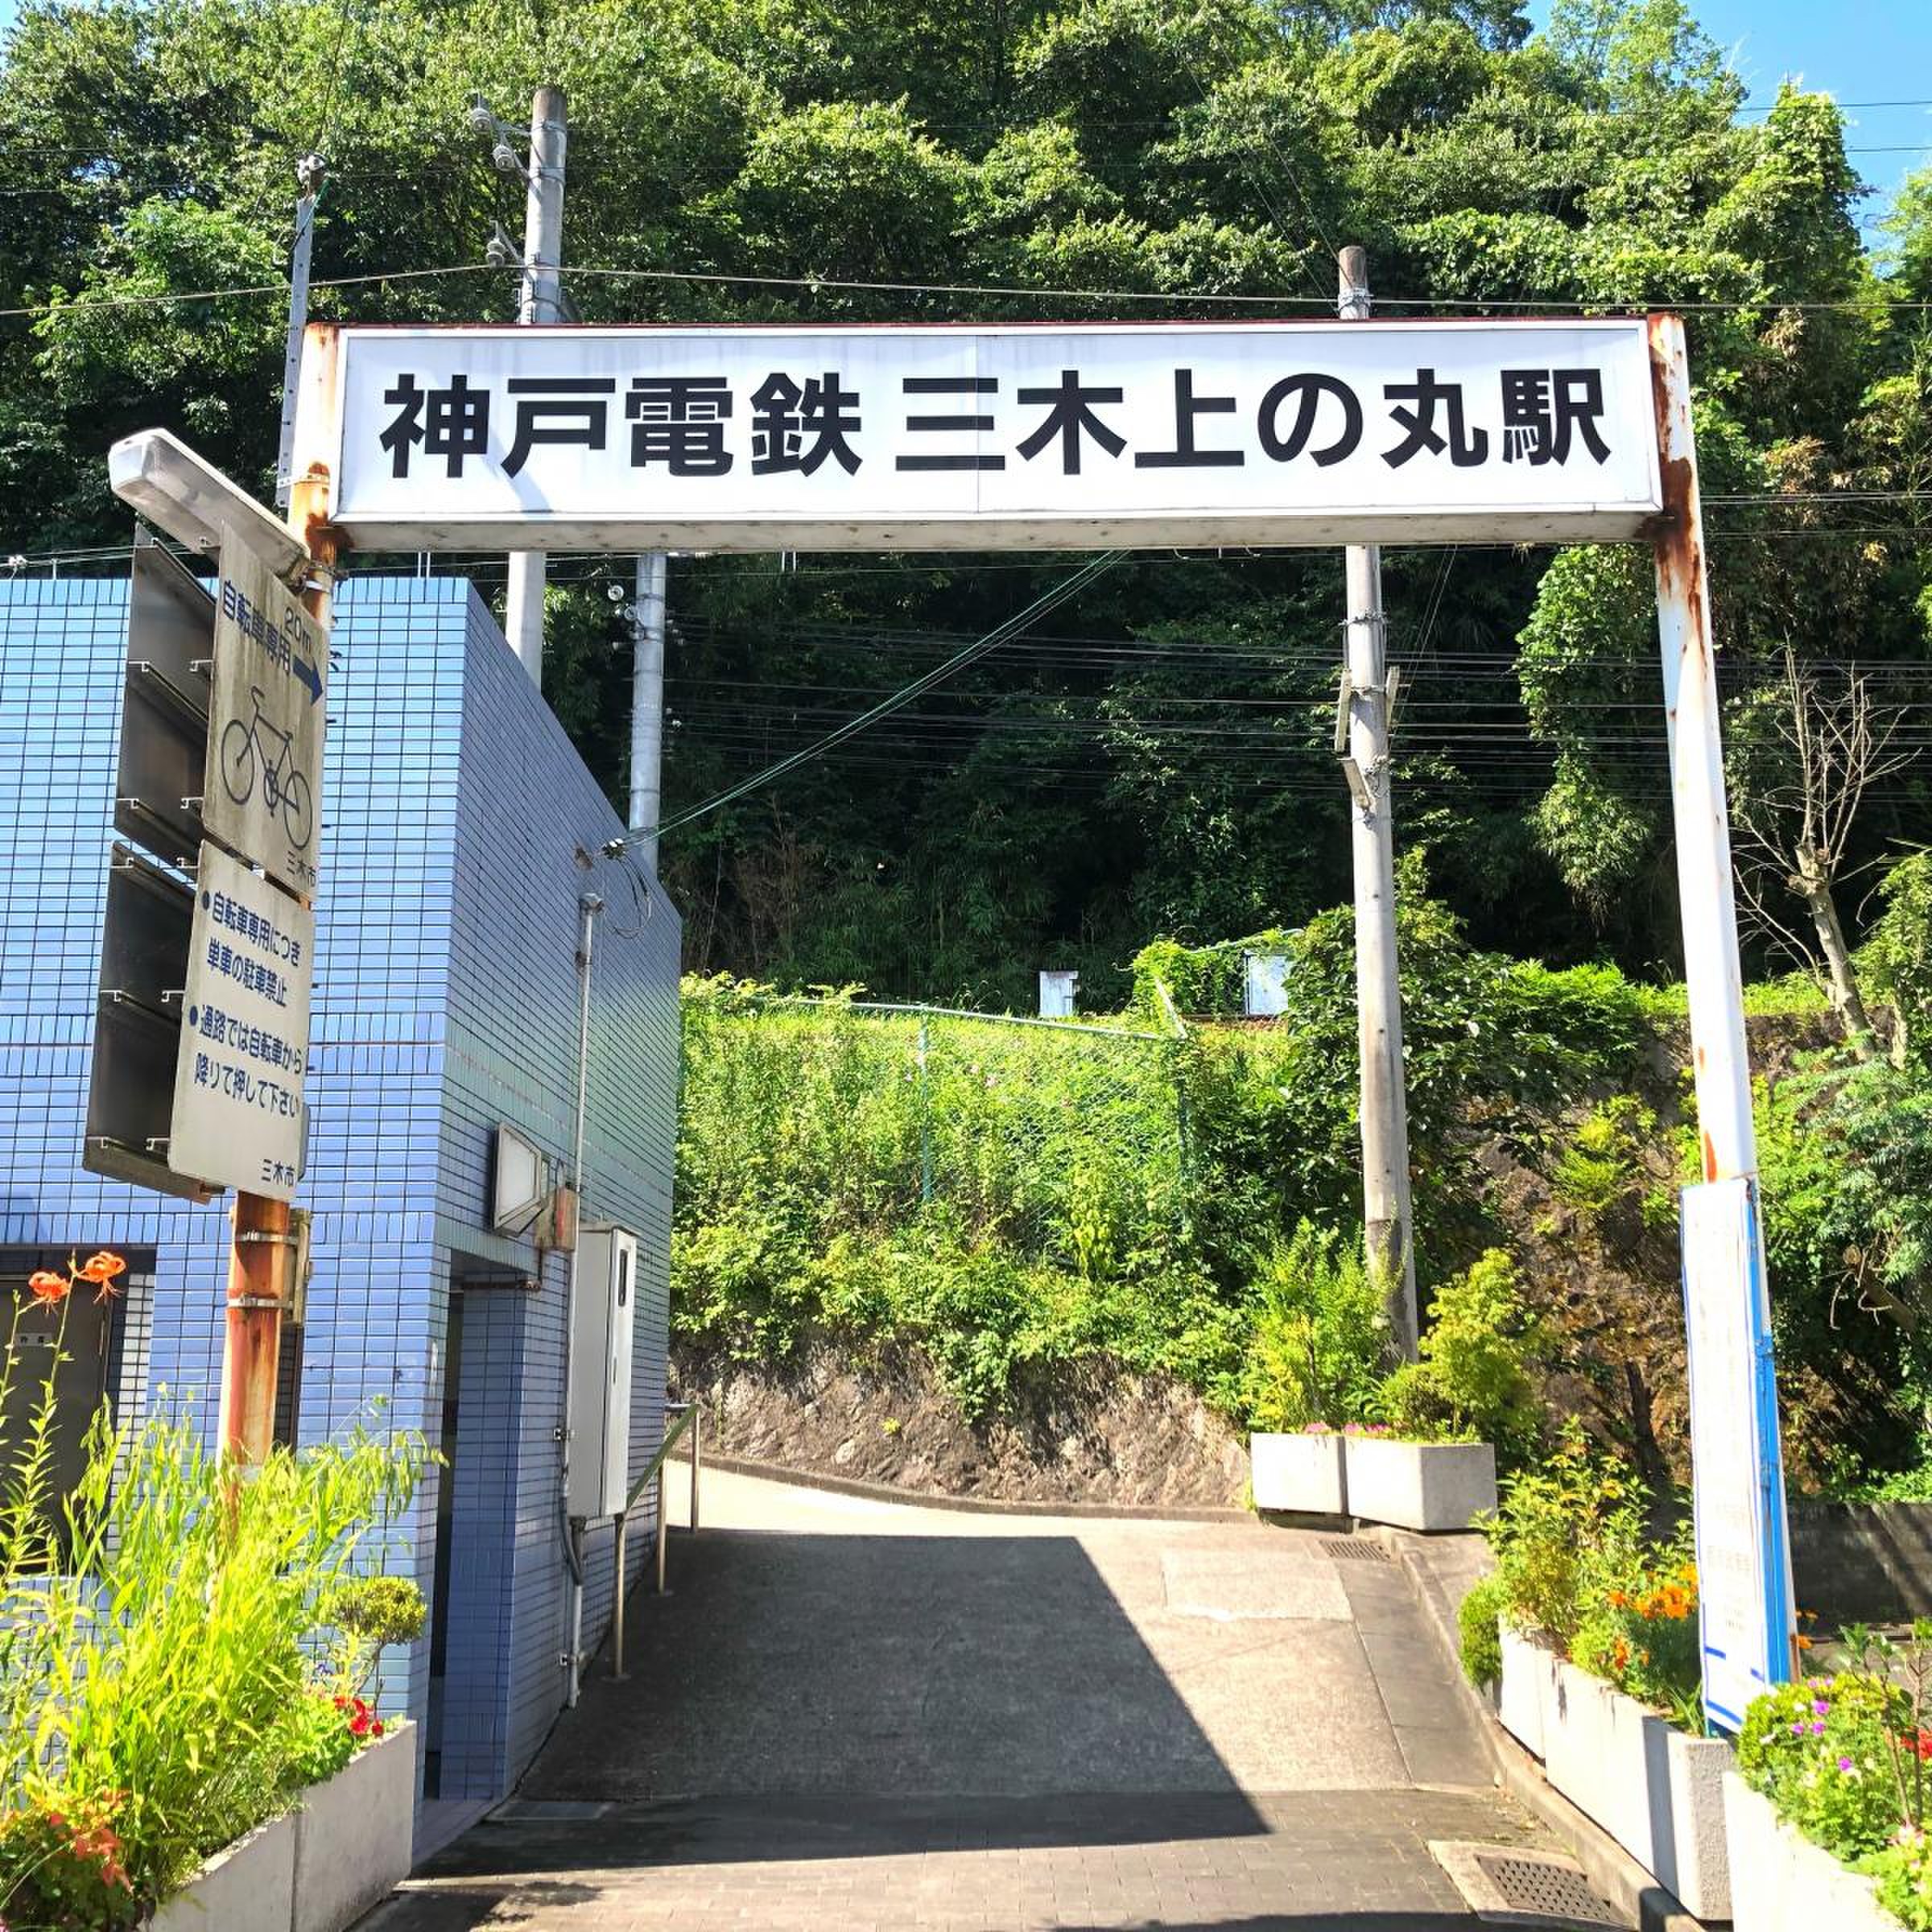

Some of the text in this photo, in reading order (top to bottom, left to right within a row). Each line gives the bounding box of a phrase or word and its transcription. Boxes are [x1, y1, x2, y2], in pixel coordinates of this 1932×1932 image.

[380, 369, 1611, 478] 神戸電鉄 三木上の丸駅
[223, 580, 291, 677] 自転車専用
[284, 606, 312, 654] 20m
[287, 851, 316, 887] 三木市
[213, 891, 301, 967] 自転車専用につき
[207, 936, 287, 1007] 単車の駐車禁止
[199, 1004, 302, 1075] 通路では自転車から
[194, 1052, 299, 1117] 降りて押して下さい
[262, 1158, 295, 1187] 三木市
